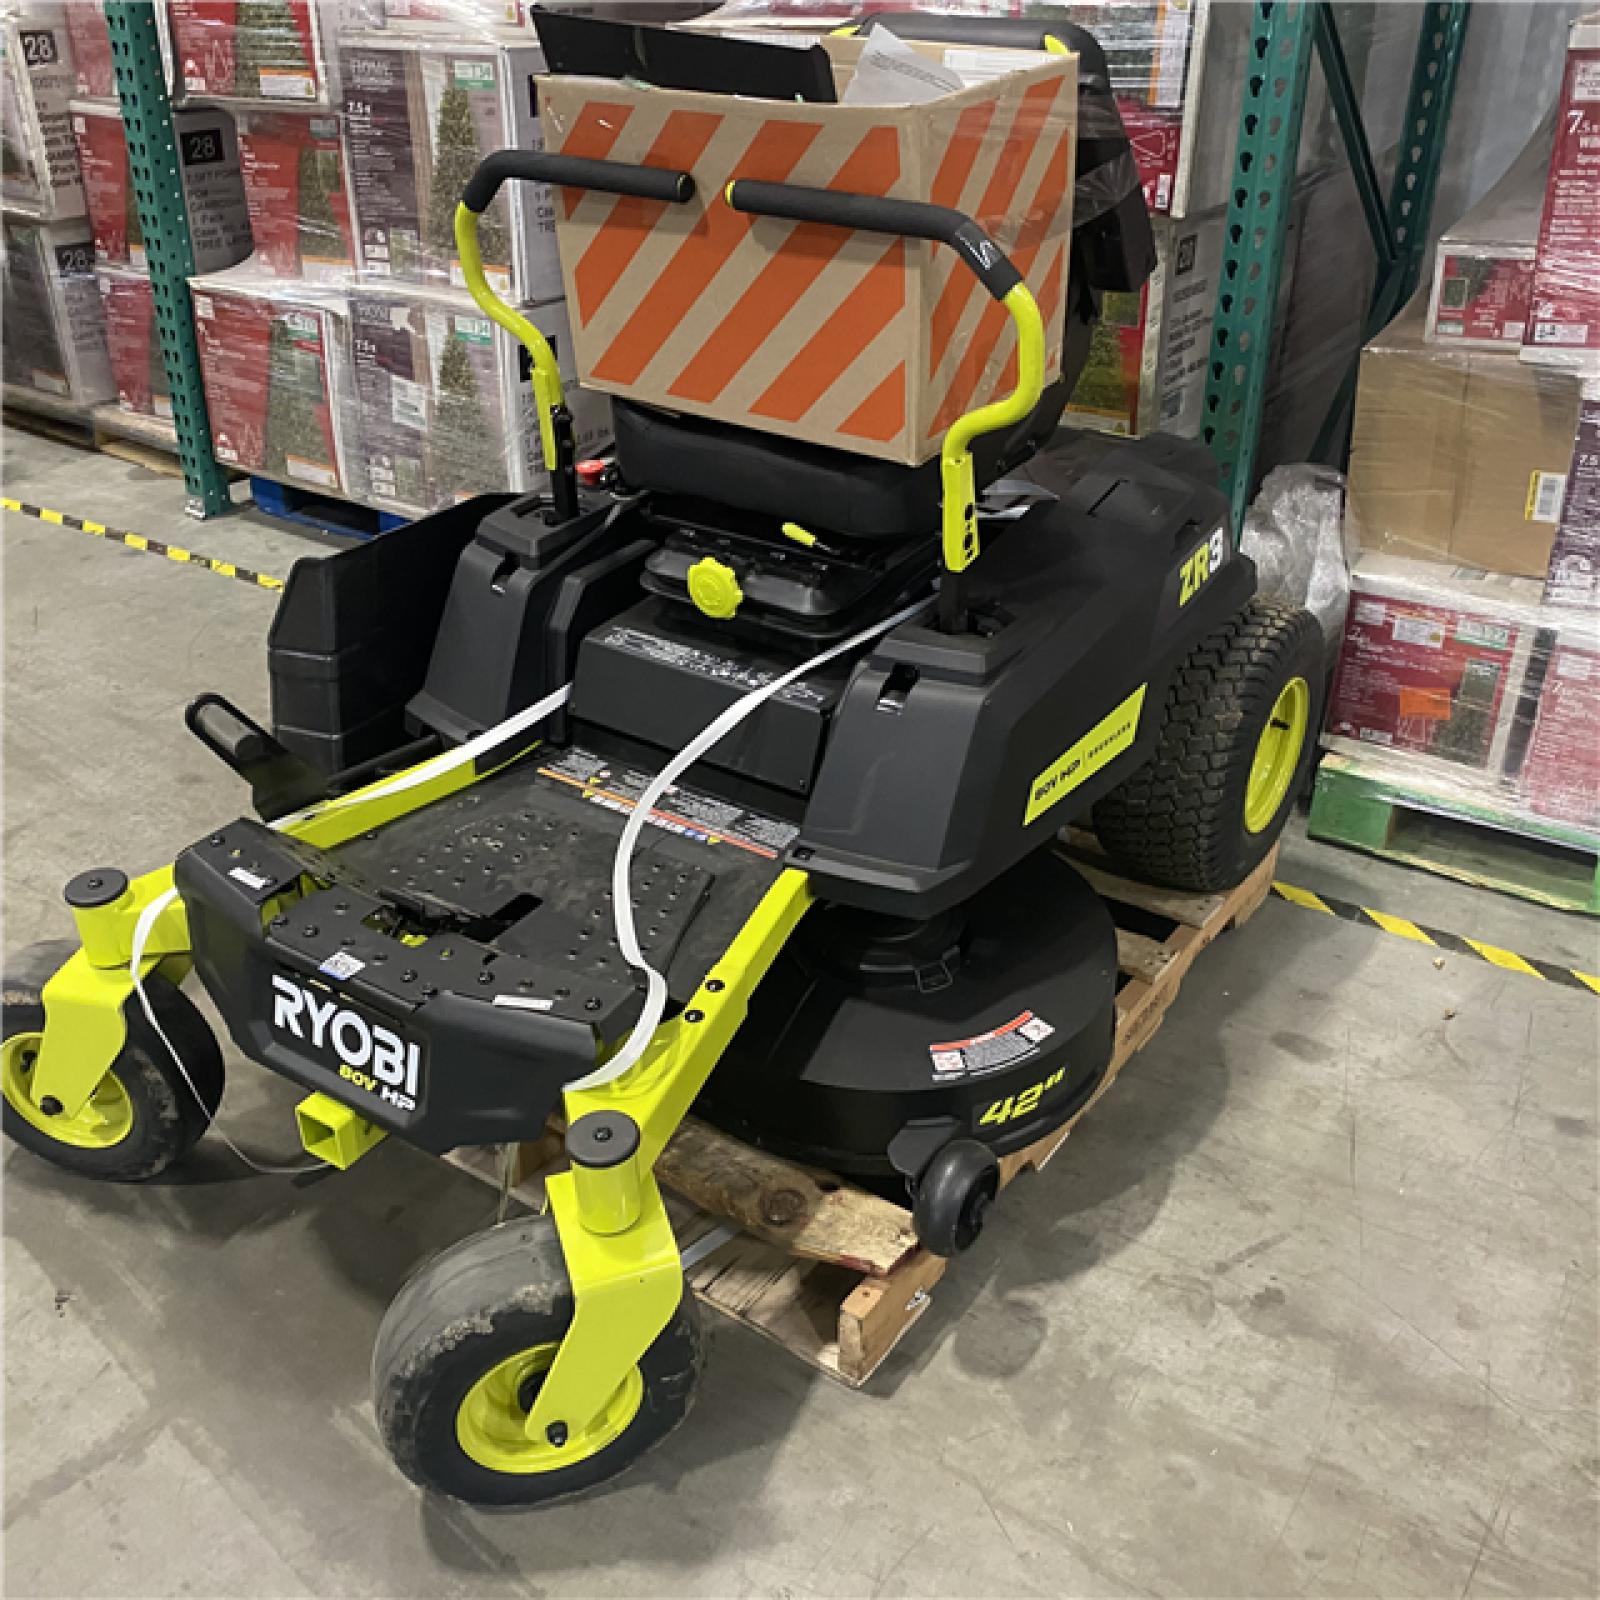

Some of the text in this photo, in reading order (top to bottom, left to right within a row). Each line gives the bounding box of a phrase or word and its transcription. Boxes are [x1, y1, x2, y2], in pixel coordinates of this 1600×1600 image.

[24, 35, 52, 60] 28
[189, 136, 217, 159] 28
[62, 249, 88, 271] 28
[272, 974, 420, 1096] RYOBI
[339, 1064, 416, 1111] 80V HP
